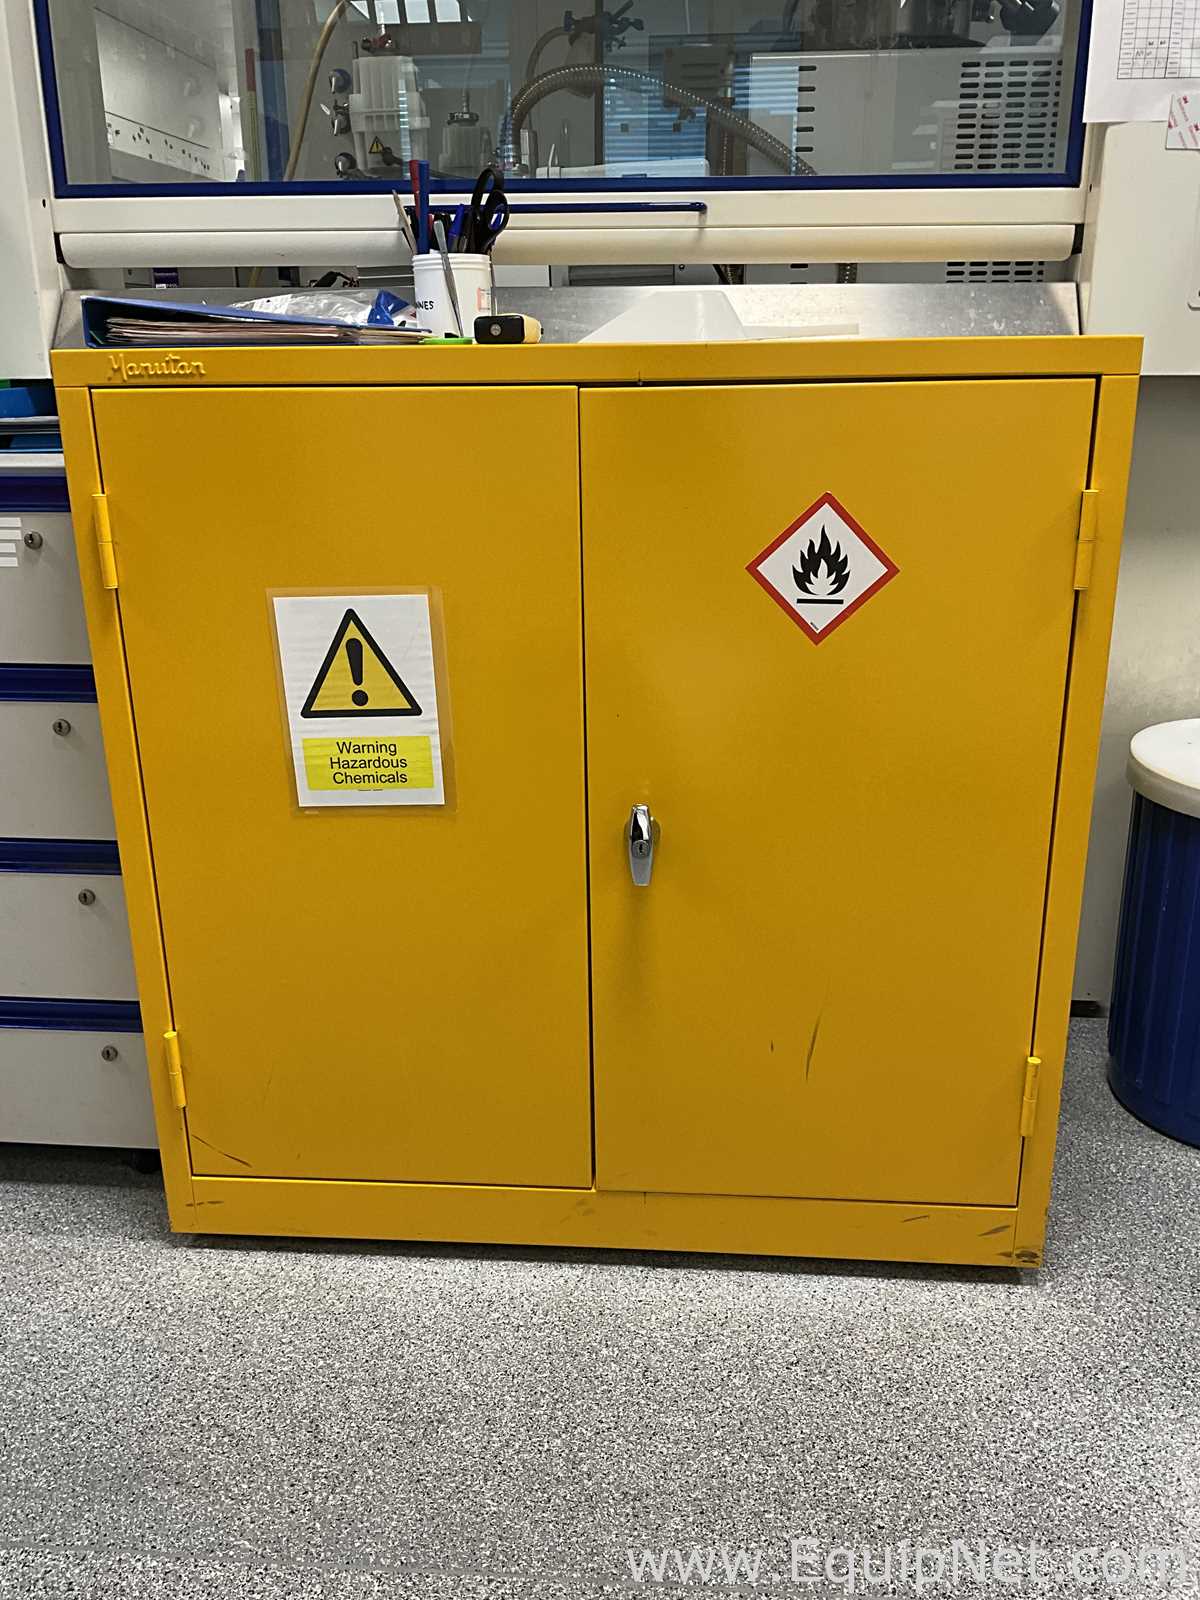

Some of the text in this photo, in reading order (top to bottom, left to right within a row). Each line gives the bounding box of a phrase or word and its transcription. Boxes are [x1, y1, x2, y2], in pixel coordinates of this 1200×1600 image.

[107, 353, 206, 381] Manutan
[336, 740, 398, 756] Warning
[329, 757, 408, 770] Hazardous
[332, 771, 408, 784] Chemicals
